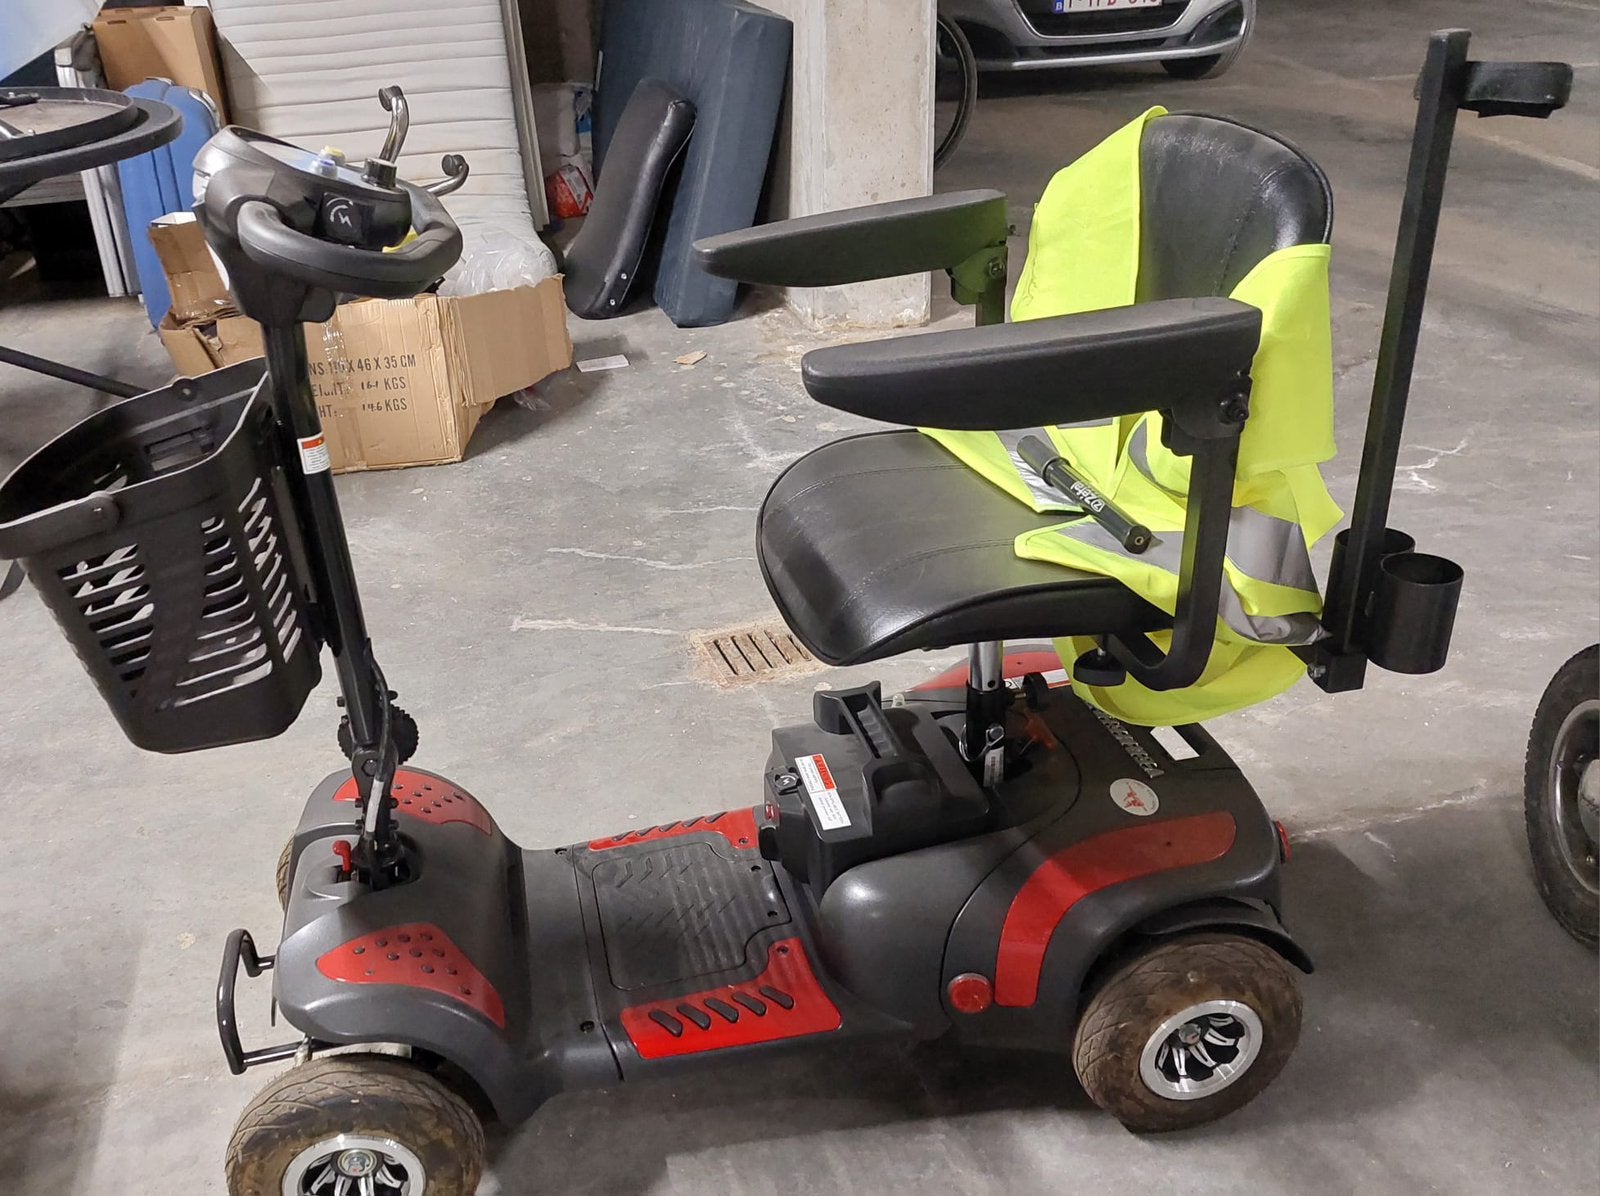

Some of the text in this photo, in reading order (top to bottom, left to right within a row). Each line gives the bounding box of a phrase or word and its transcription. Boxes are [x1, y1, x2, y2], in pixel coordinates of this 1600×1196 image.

[347, 359, 355, 373] X
[357, 358, 371, 372] 46
[374, 357, 381, 370] X
[385, 355, 398, 369] 35
[400, 354, 416, 368] CM
[384, 376, 406, 390] KGS
[385, 398, 408, 412] KGS
